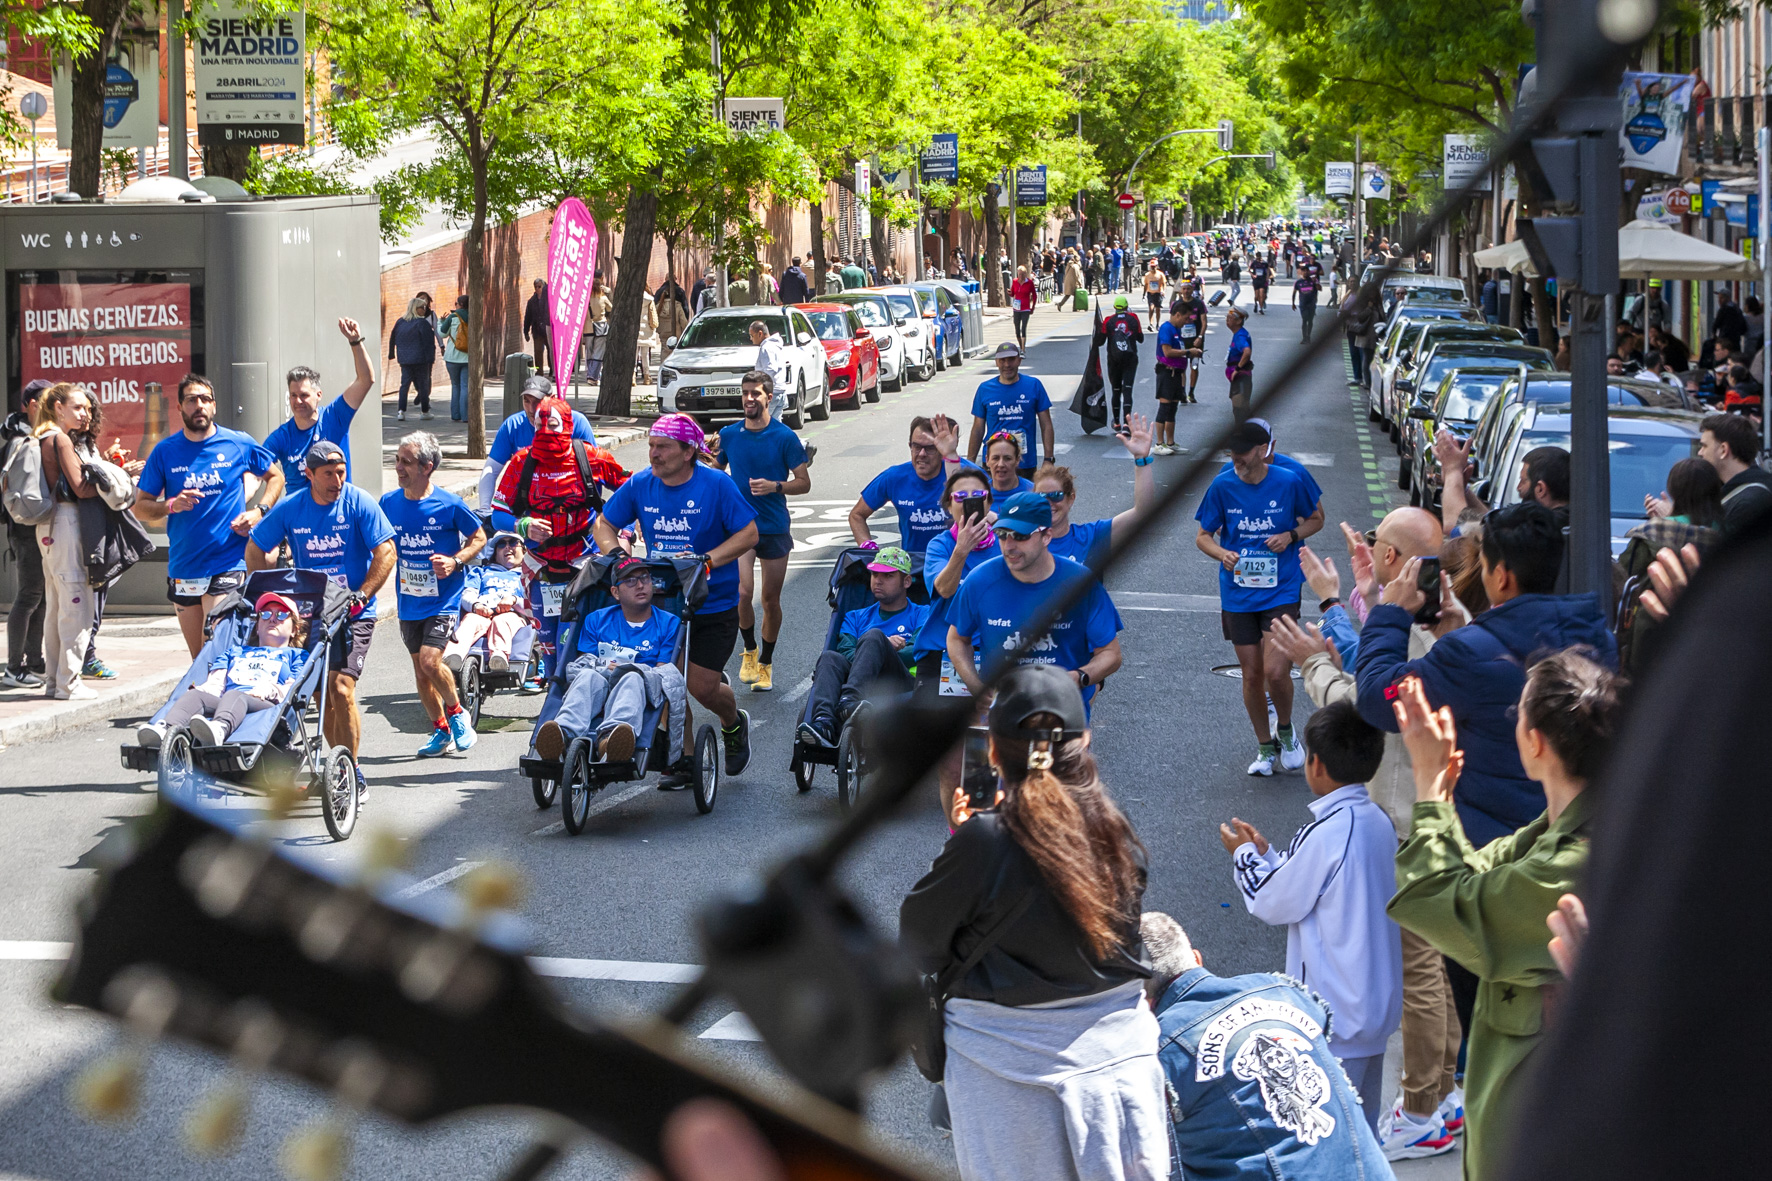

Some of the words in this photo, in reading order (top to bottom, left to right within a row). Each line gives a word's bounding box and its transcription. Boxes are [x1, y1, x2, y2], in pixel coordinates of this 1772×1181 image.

[207, 19, 294, 37] SIENTE
[201, 37, 299, 56] MADRID
[201, 58, 219, 66] UNA
[221, 58, 244, 66] META
[246, 58, 299, 66] INOLVIDABLE
[732, 110, 776, 120] SIENTE
[729, 121, 779, 130] MADD
[238, 130, 279, 139] MADRID
[930, 141, 954, 149] ENTE
[921, 149, 956, 157] MADRID
[1667, 192, 1689, 206] ria
[21, 233, 51, 248] WC
[576, 289, 588, 324] BIZUM
[25, 307, 90, 332] BUENAS
[93, 304, 183, 330] CERVEZAS.
[40, 344, 105, 369] BUENOS
[108, 341, 183, 366] PRECIOS.
[101, 377, 144, 403] DÍAS.
[655, 533, 690, 541] #imparables
[1244, 561, 1266, 570] 7129
[406, 571, 428, 582] 10489
[549, 589, 563, 599] 106
[988, 618, 1011, 627] aefat
[1050, 621, 1073, 629] RICH
[1016, 656, 1056, 664] parables
[1202, 1032, 1224, 1076] SONS
[1218, 1014, 1238, 1030] OF
